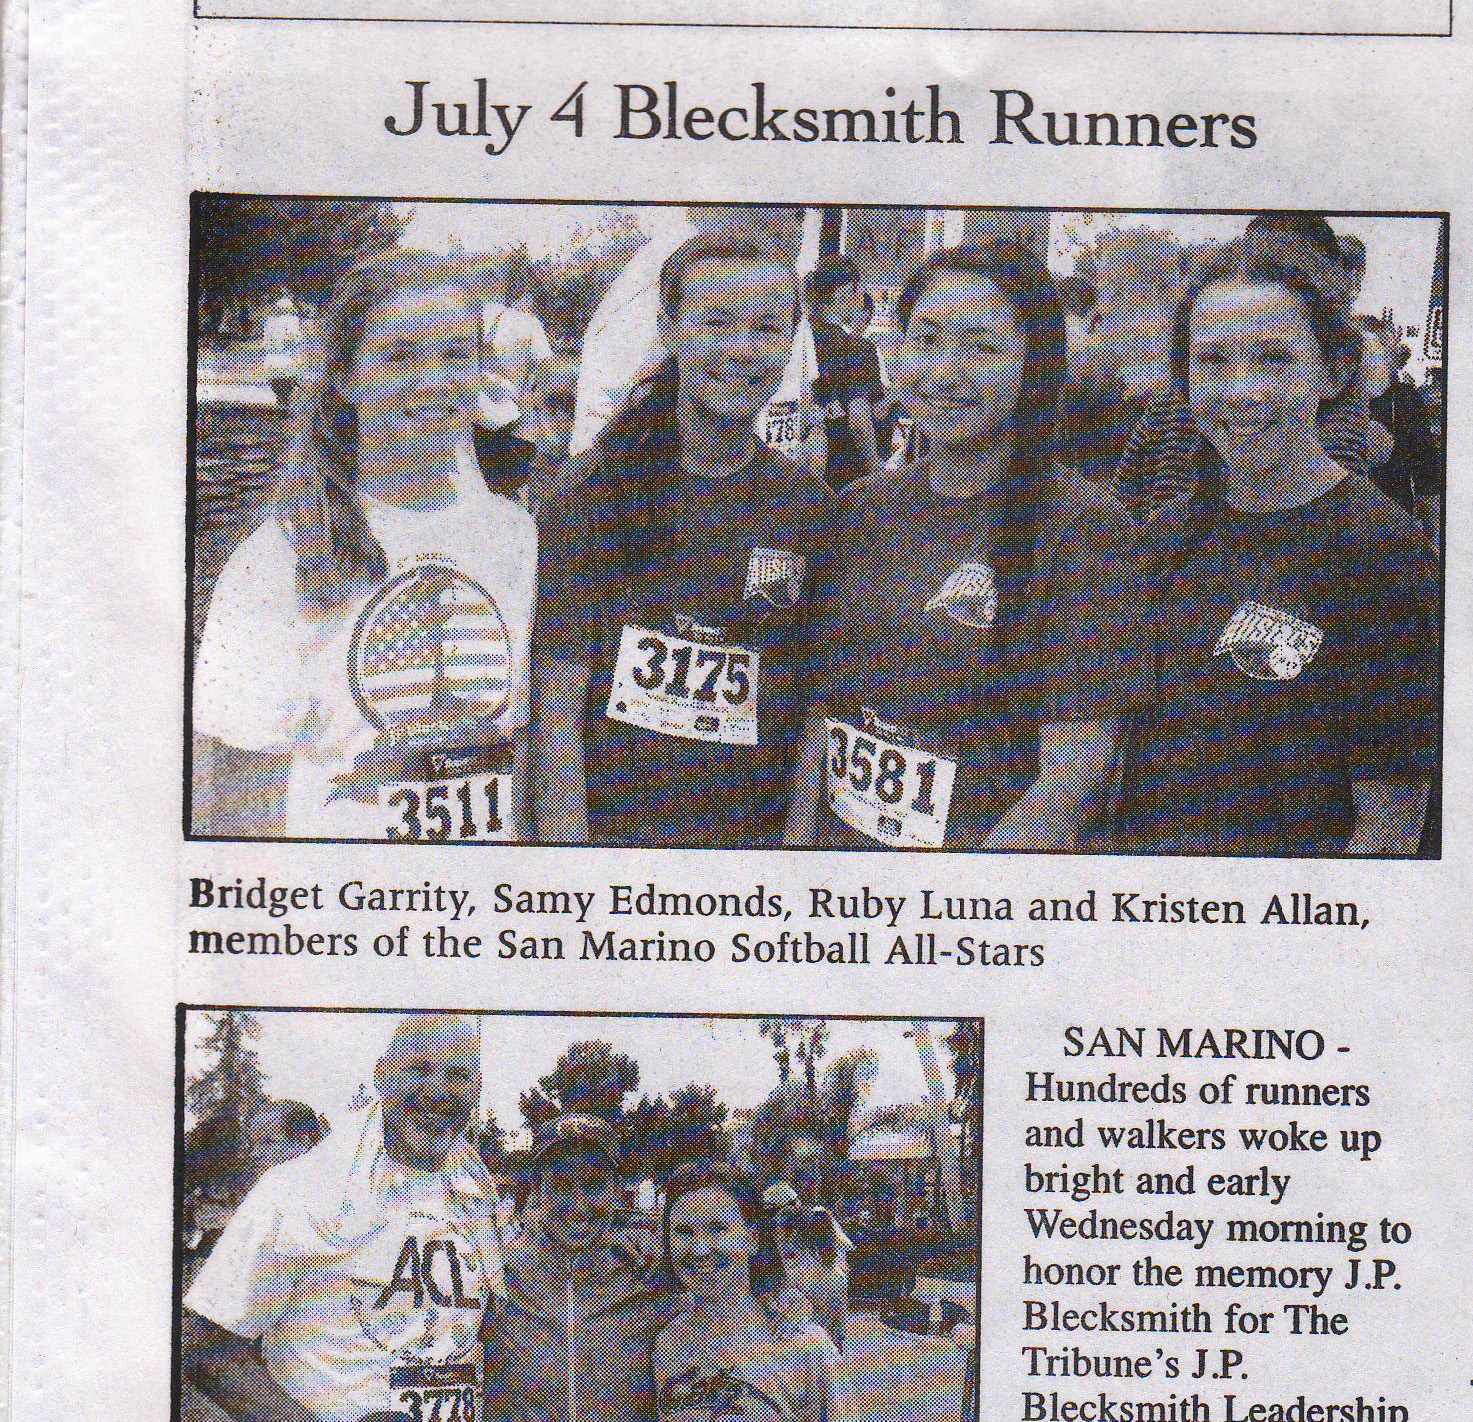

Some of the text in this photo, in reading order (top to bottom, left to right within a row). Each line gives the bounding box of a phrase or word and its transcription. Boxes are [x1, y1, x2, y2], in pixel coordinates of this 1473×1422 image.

[384, 77, 1258, 156] July 4 Blecksmith Runners
[632, 636, 751, 705] 3175
[829, 727, 936, 815] 3581
[386, 777, 502, 840] 3511
[189, 877, 1370, 930] Bridget Garrity, Samy Edmonds, Ruby Luna and Kristen Allan,
[188, 923, 1045, 967] members of the San Marino Softball All-Stars
[1063, 1026, 1325, 1061] SAN MARINO
[1025, 1071, 1371, 1107] Hundreds of runners
[1024, 1208, 1412, 1253] Wednesday morning to
[1023, 1254, 1402, 1298] honor the memory J.P.
[1022, 1300, 1349, 1336] Blecksmith for The
[1191, 1348, 1248, 1380] J.P.
